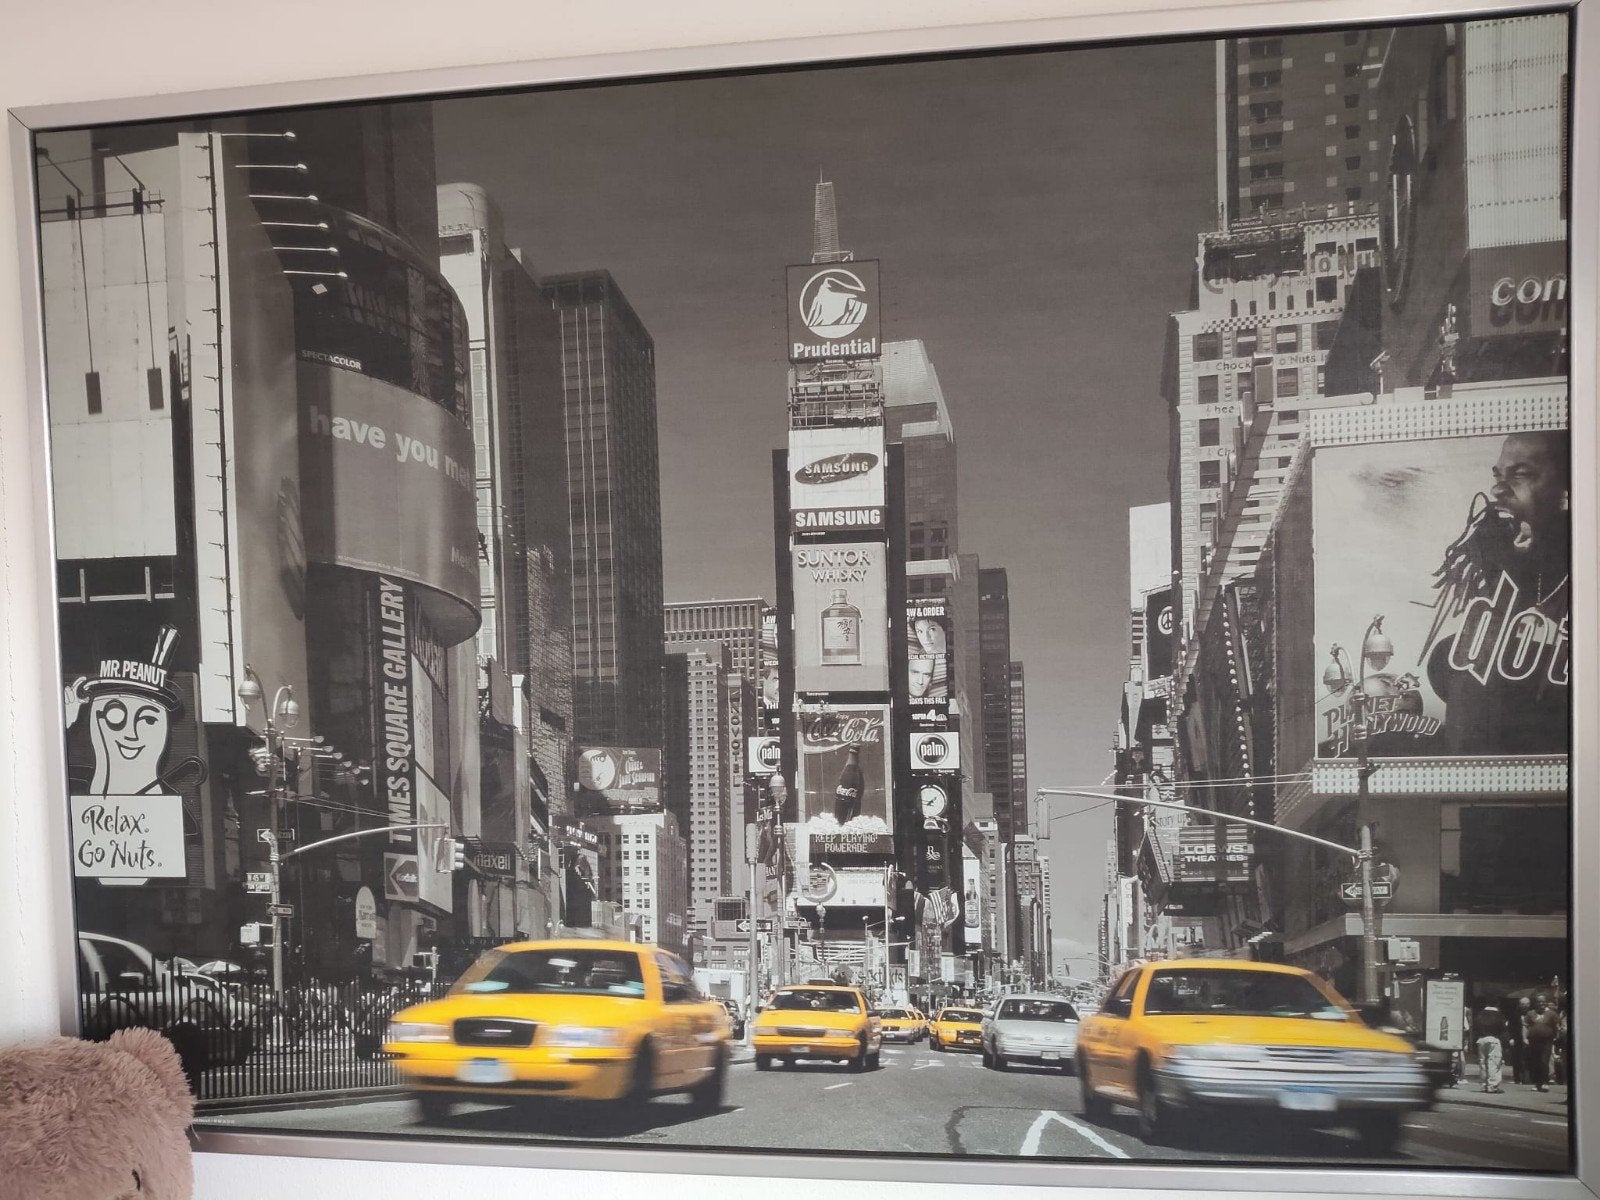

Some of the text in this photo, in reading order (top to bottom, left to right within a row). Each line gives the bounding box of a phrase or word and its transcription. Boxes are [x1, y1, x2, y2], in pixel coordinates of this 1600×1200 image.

[793, 337, 876, 359] Prudential
[301, 348, 362, 371] SPECTACOLOR
[308, 404, 387, 449] have
[395, 431, 439, 470] you
[804, 461, 870, 475] SAMSUNG
[795, 508, 881, 528] SAMSUNG
[810, 568, 867, 584] WHISKY
[762, 615, 777, 625] LAW
[923, 606, 945, 617] ORDER
[100, 660, 167, 687] MR. PEANUT
[380, 577, 412, 844] TIMES SQUARE GALLERY
[935, 697, 946, 705] FALL
[920, 741, 945, 757] palm
[81, 804, 150, 835] Relax.
[815, 833, 836, 844] KEEP
[824, 843, 868, 854] POWERADE
[78, 839, 163, 870] Go Nuts.
[473, 851, 511, 871] maxell
